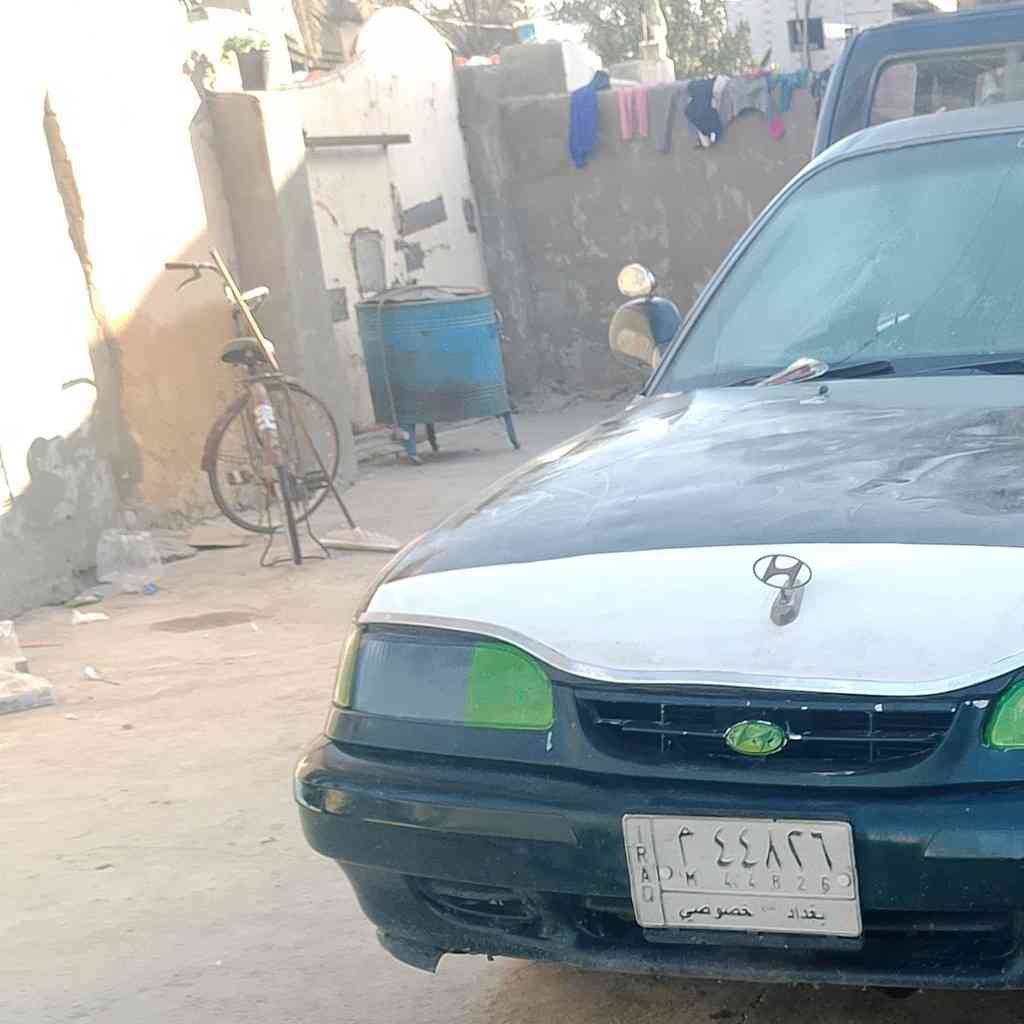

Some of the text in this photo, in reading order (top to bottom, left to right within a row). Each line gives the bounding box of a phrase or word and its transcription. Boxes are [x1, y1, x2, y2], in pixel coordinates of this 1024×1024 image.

[713, 826, 834, 873] ٤٤٨٢٦
[679, 904, 754, 922] خصوصي
[786, 904, 826, 926] بغداد
